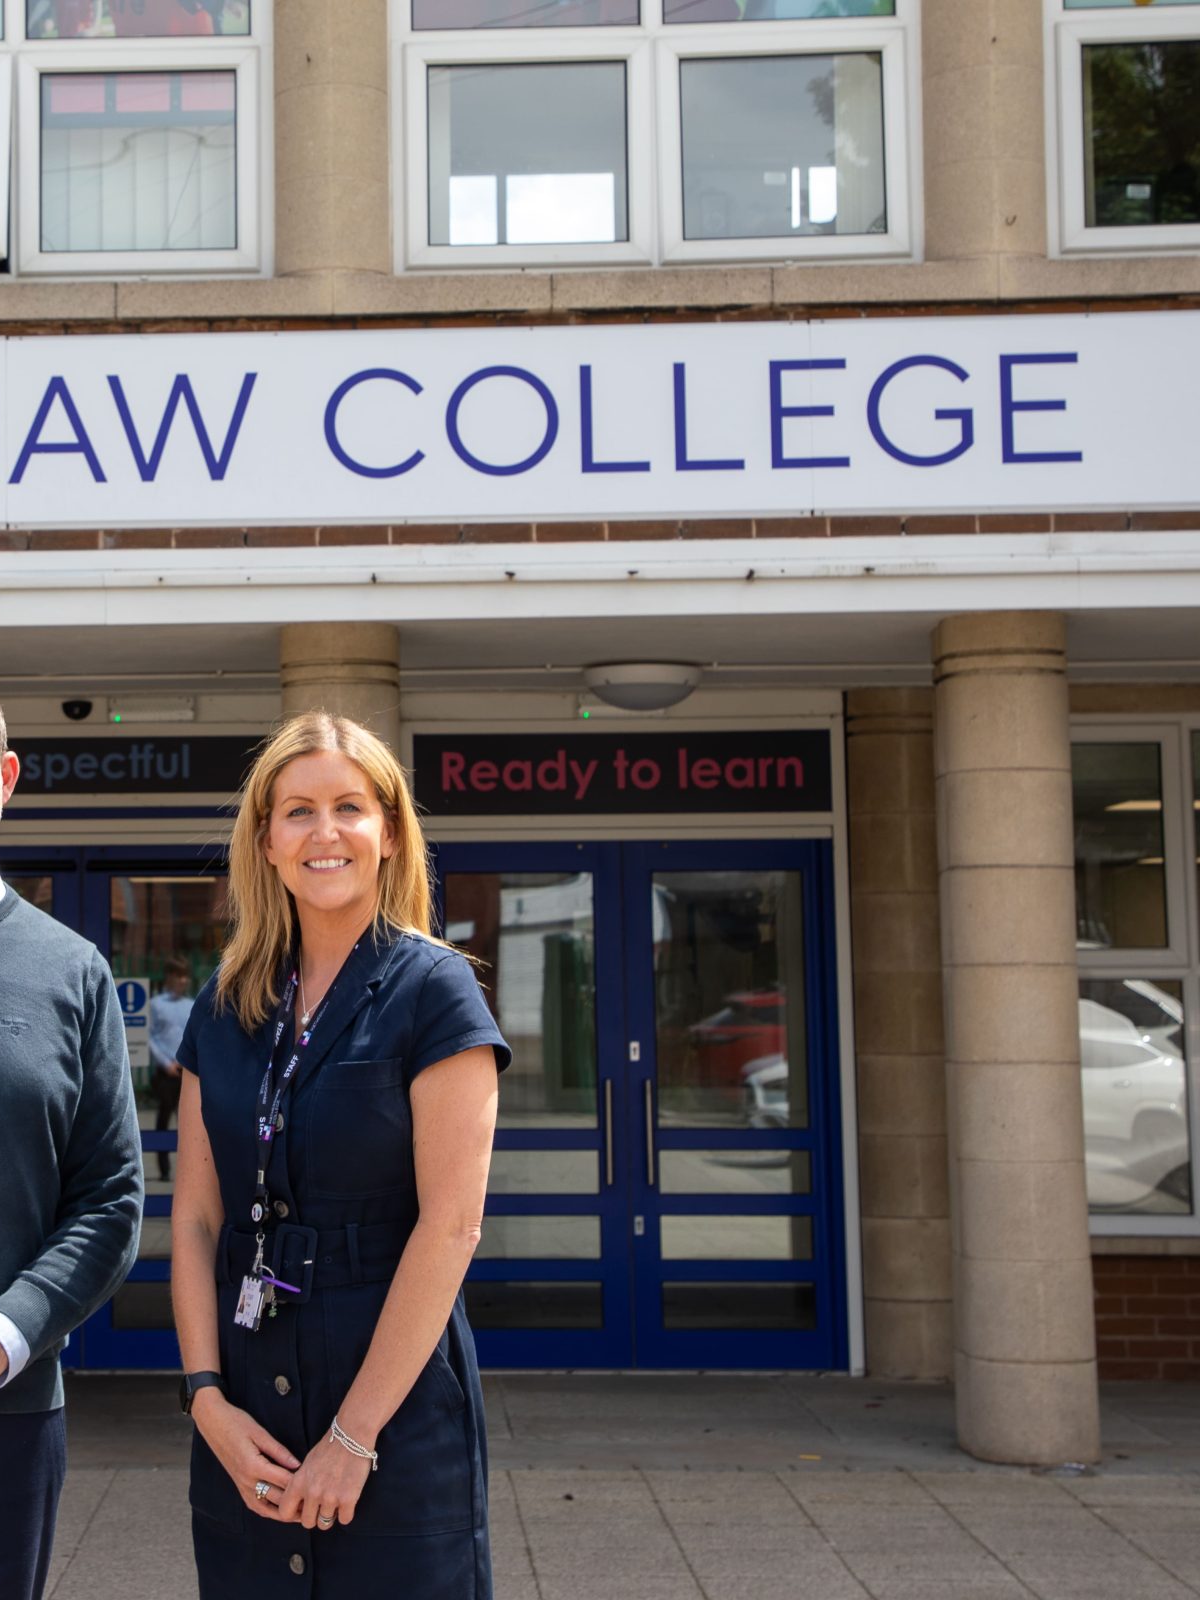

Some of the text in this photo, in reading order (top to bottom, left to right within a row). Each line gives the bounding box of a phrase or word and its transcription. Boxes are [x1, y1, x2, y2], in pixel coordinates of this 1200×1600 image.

[324, 351, 1083, 479] COLLEGE
[24, 743, 191, 788] spectful
[441, 748, 804, 800] Ready to learn
[283, 1054, 299, 1078] STAFF
